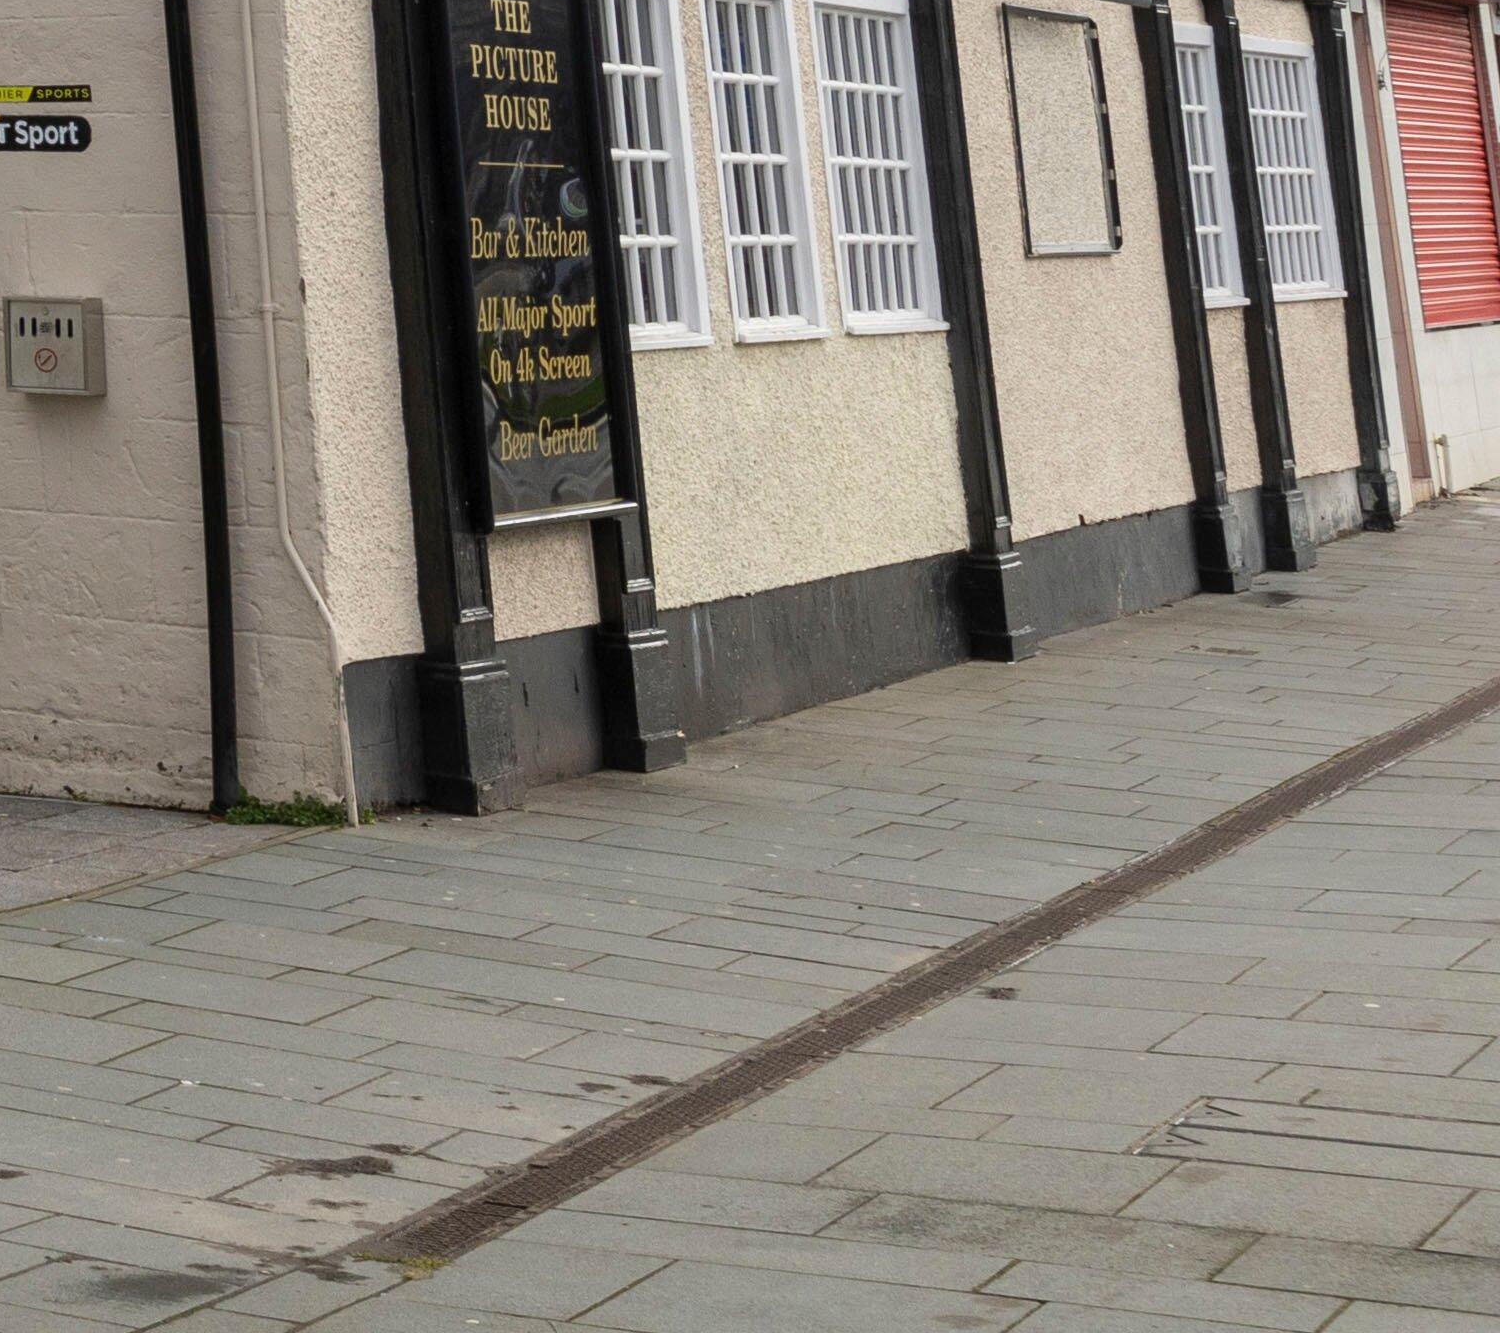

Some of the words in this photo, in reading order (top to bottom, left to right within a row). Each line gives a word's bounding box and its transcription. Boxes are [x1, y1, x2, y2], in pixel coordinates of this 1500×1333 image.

[469, 43, 558, 85] PICTURE
[36, 87, 90, 99] SPORTS
[484, 93, 552, 132] HOUSE
[14, 120, 79, 149] Sport
[470, 217, 501, 260] Bar
[506, 229, 520, 258] &
[524, 216, 590, 259] Kitchen
[476, 297, 497, 334] All
[501, 293, 548, 339] Major
[552, 297, 597, 337] Sport
[490, 349, 513, 384] On
[516, 347, 534, 383] 4k
[538, 347, 592, 381] Screen
[500, 421, 535, 462] Beer
[538, 413, 599, 456] Garden
